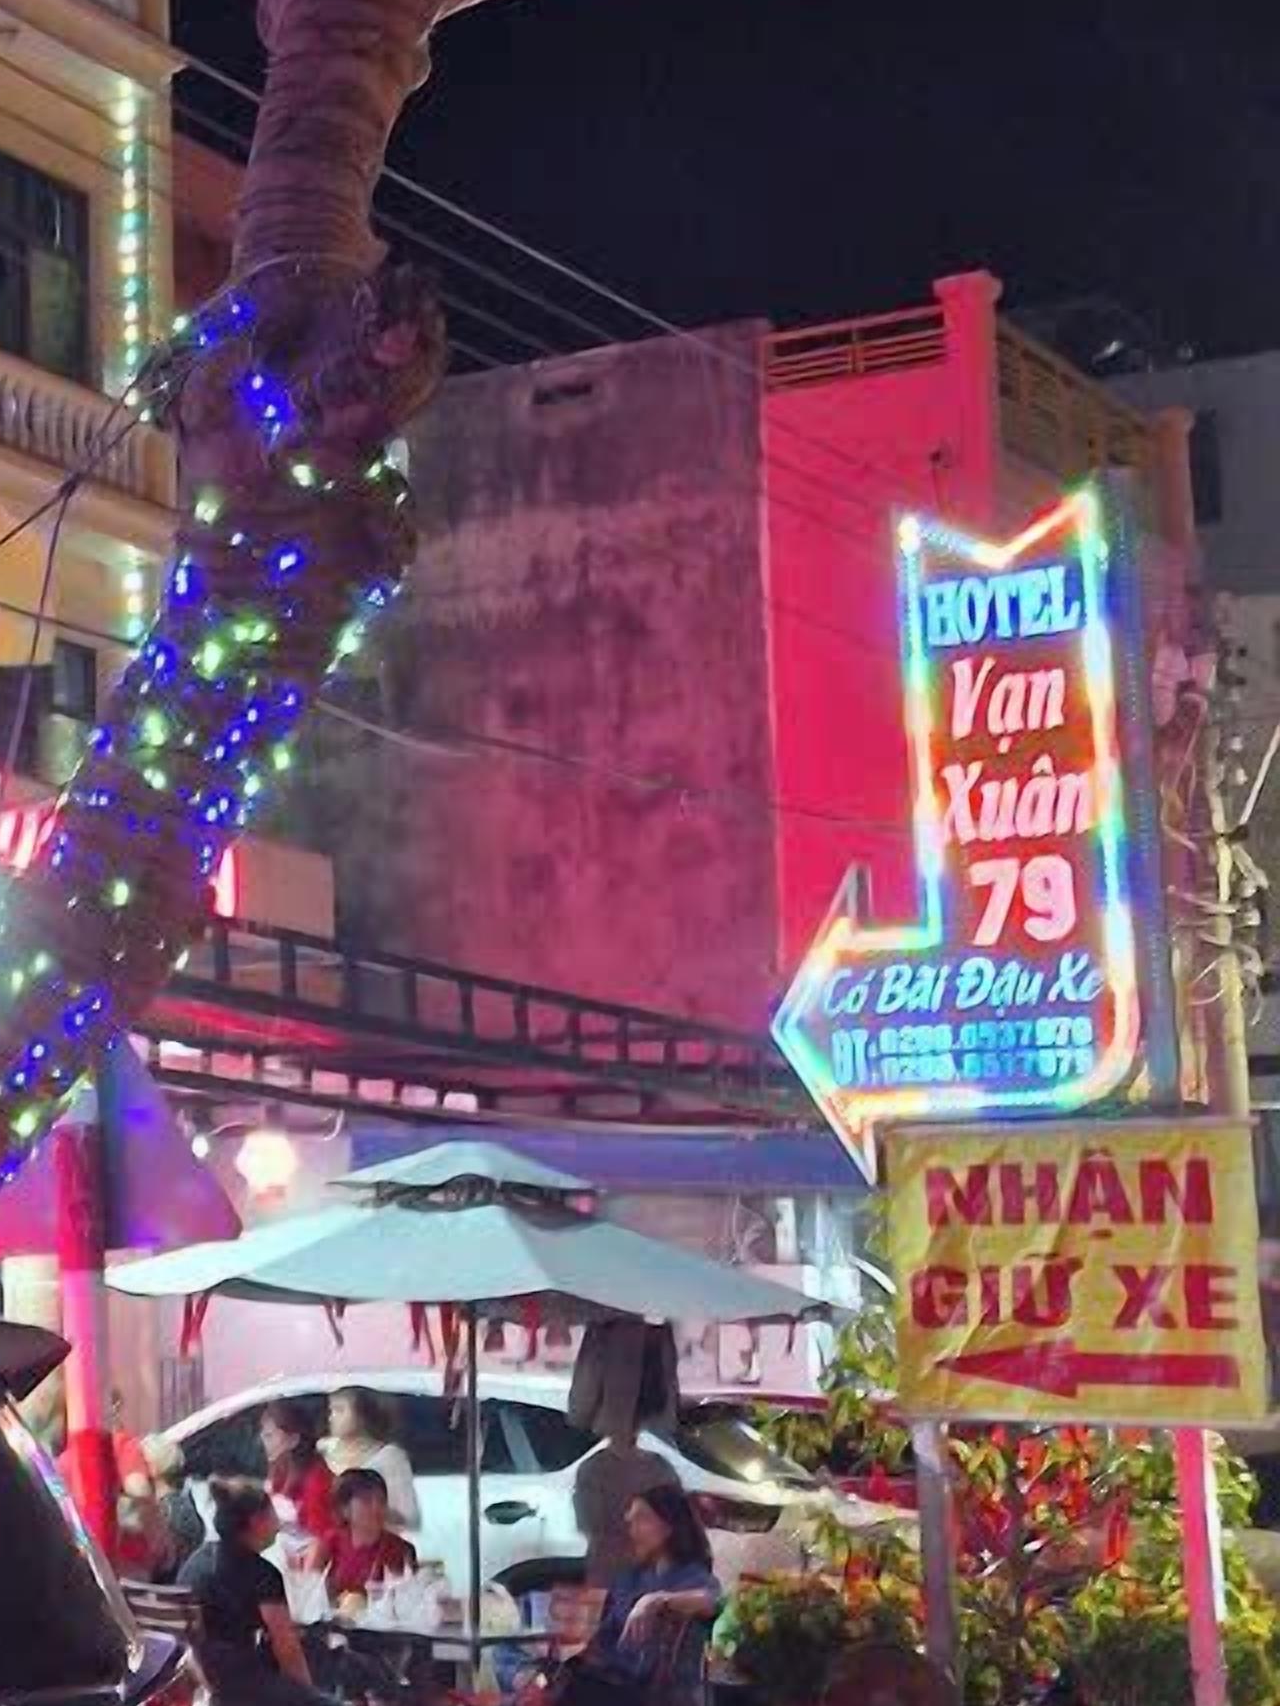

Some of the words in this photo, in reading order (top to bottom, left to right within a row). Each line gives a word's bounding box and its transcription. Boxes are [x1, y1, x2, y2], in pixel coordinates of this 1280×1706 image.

[925, 564, 1082, 648] HOTEL
[951, 656, 1066, 754] Vạn
[939, 752, 1096, 846] Xuân
[967, 853, 1077, 947] 79
[1045, 950, 1106, 1003] Xe
[924, 1146, 1215, 1241] NHẬN
[1111, 1263, 1241, 1331] XE
